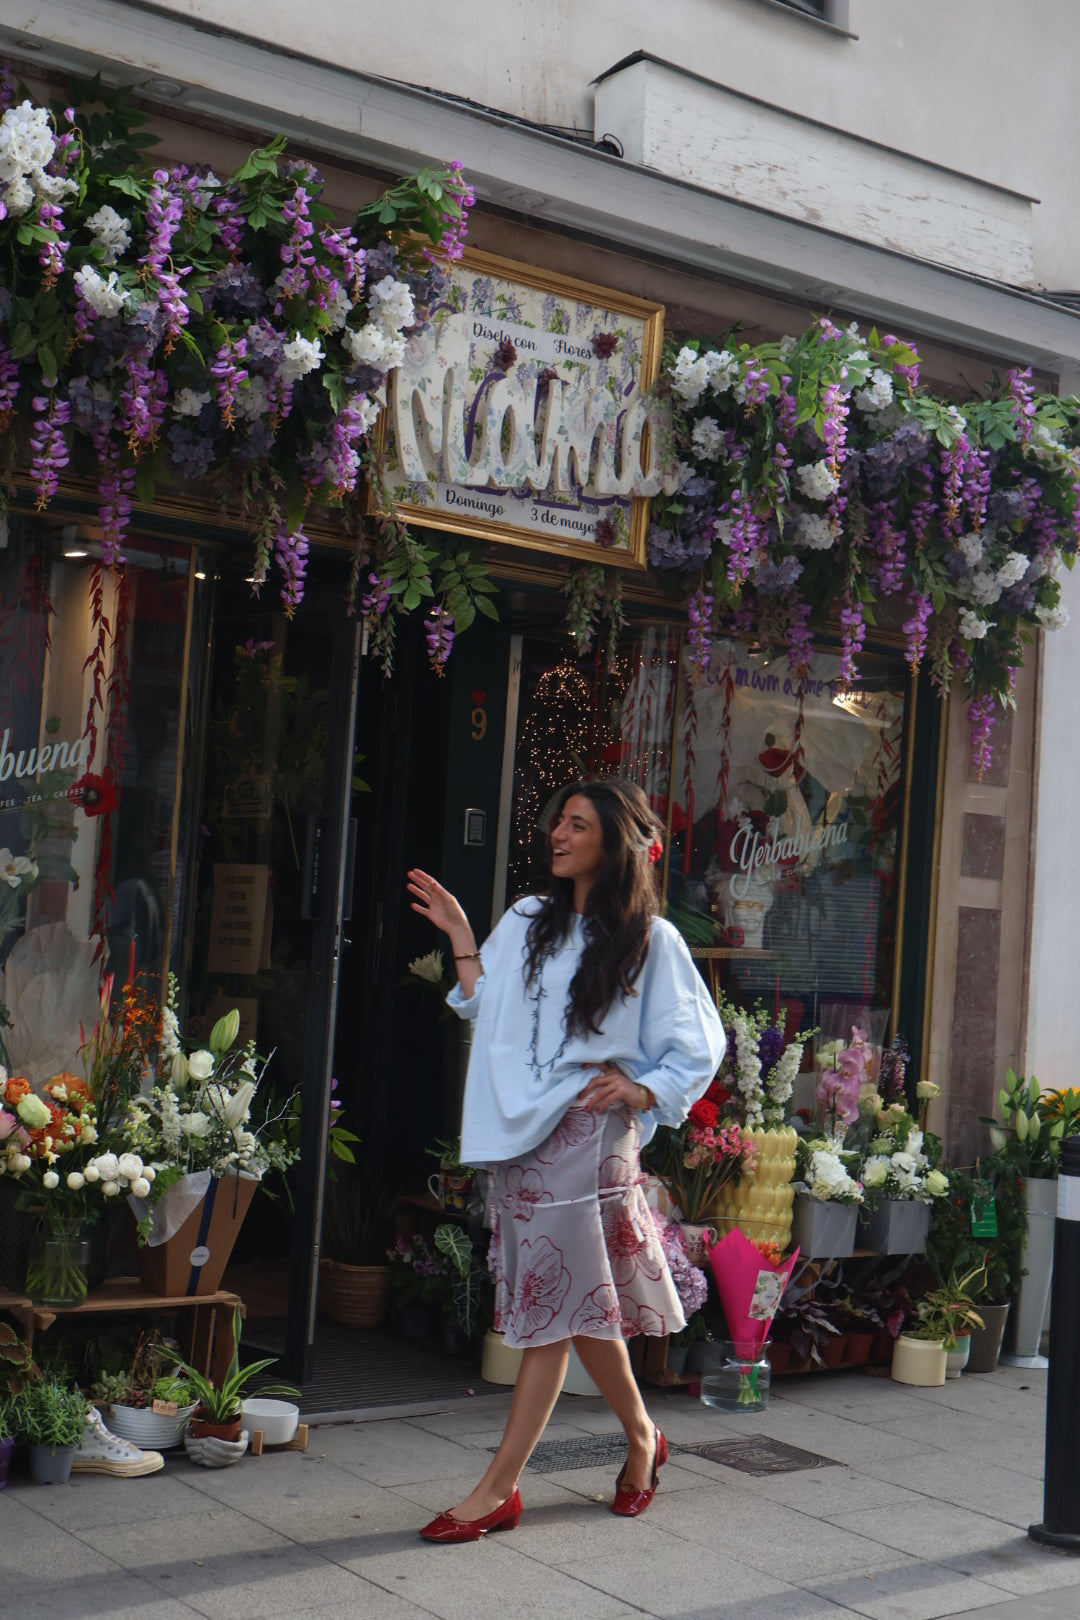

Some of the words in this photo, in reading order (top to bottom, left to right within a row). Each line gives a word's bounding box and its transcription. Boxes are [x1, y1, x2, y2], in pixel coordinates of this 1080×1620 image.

[514, 337, 538, 352] con
[553, 339, 594, 360] Flores
[445, 488, 505, 518] Domingo
[530, 508, 538, 522] 3
[540, 510, 559, 526] de
[560, 517, 596, 536] mayo
[471, 707, 487, 741] 9
[26, 794, 42, 804] TEA
[729, 814, 849, 900] Yerbabuena
